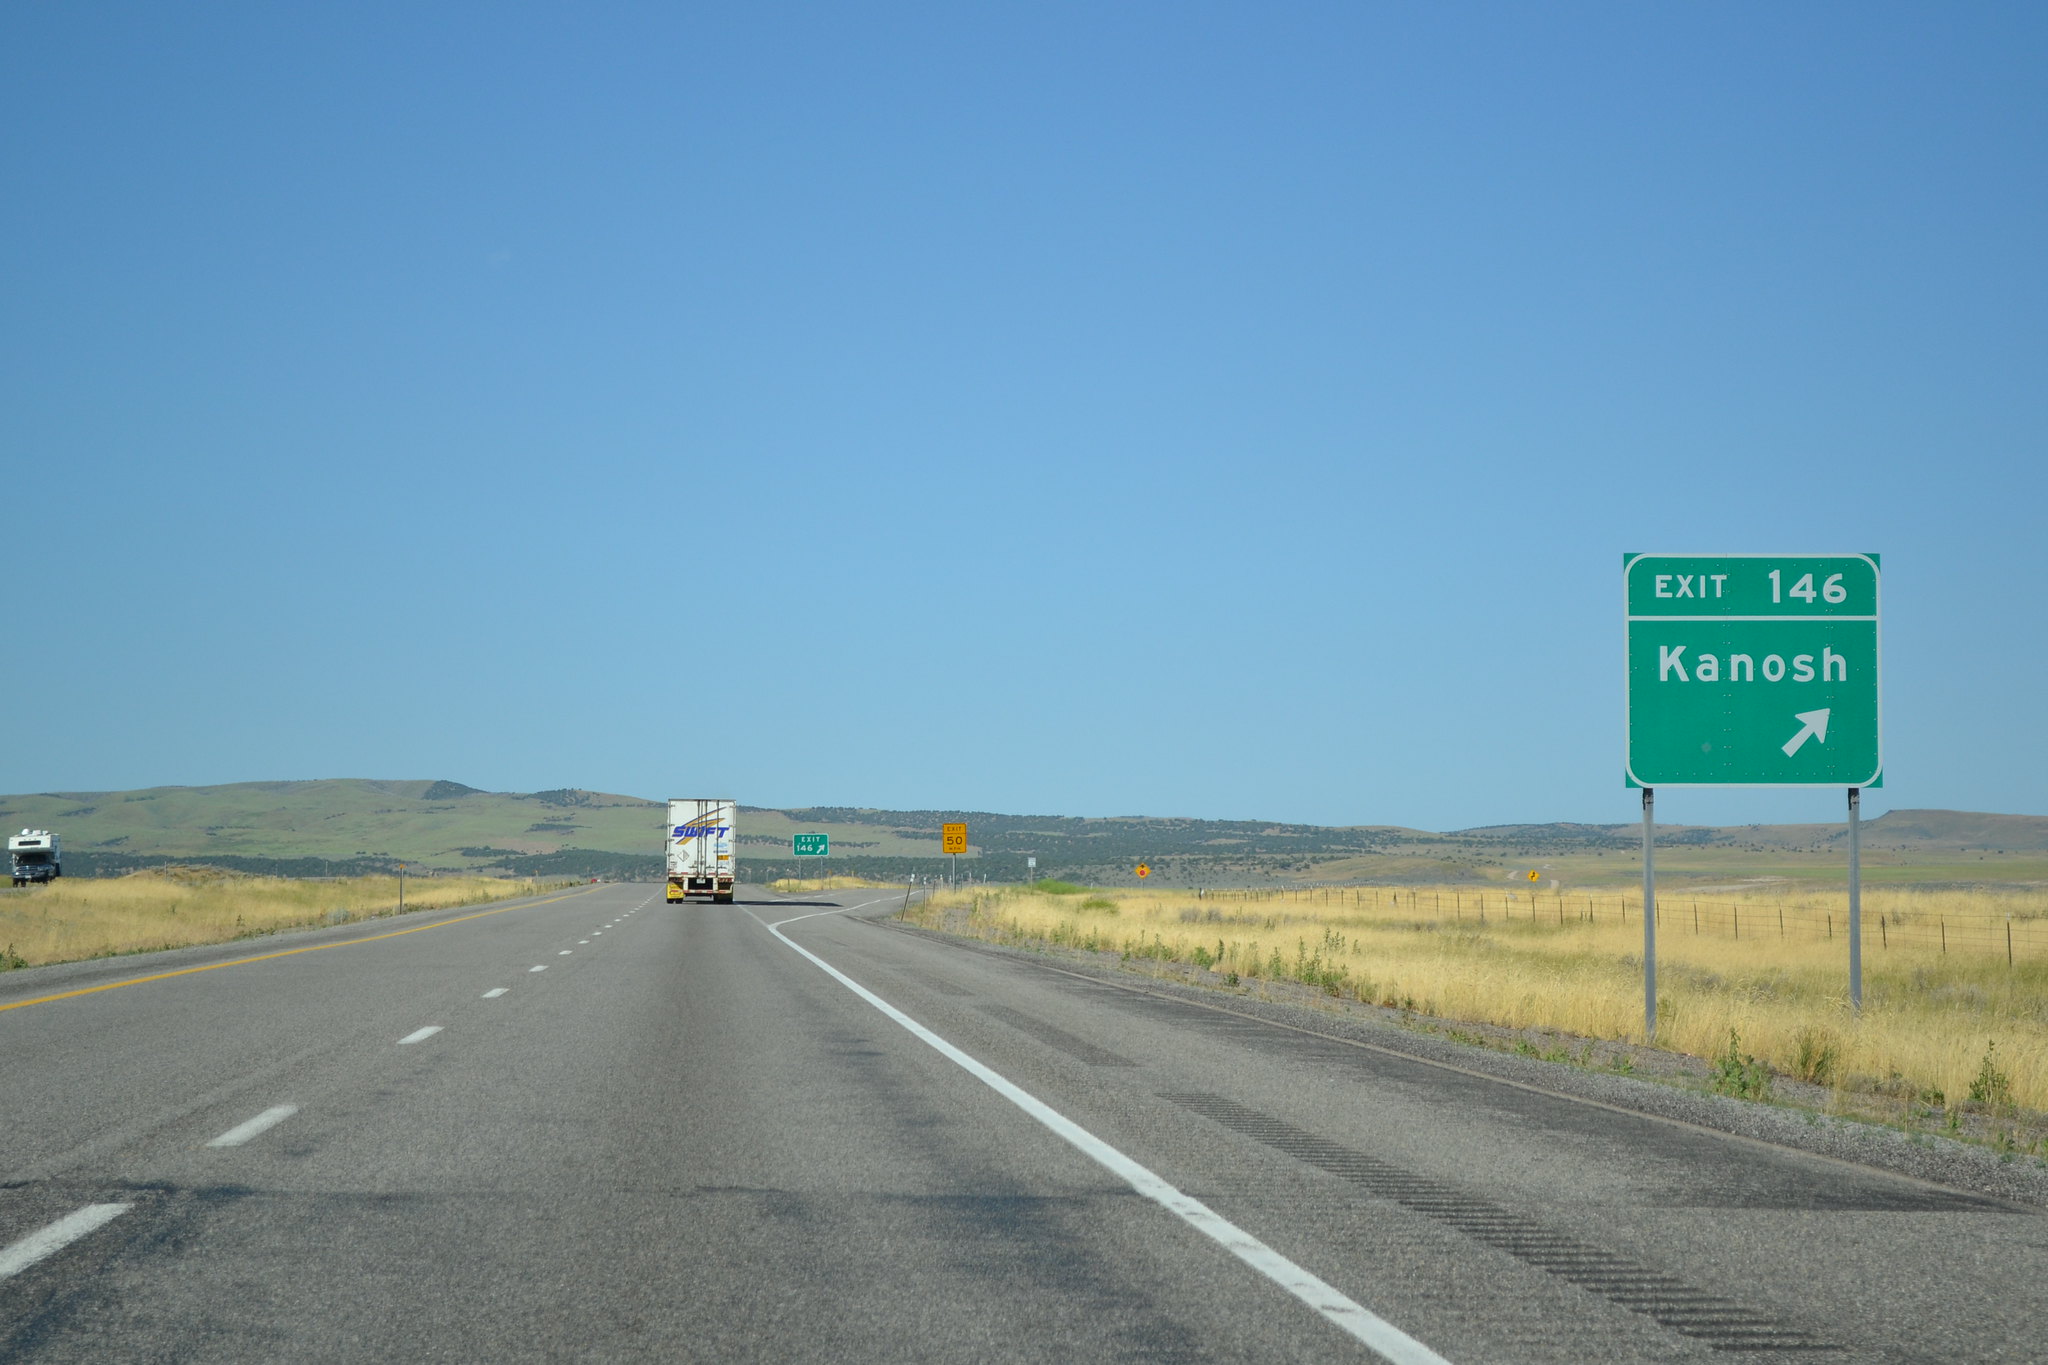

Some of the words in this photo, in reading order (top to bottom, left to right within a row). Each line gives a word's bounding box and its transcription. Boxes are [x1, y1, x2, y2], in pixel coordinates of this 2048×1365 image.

[1655, 575, 1727, 598] EXIT
[1768, 569, 1847, 603] 146
[1659, 645, 1847, 682] Kanosh
[672, 824, 730, 838] SWIFT
[946, 836, 963, 845] 50
[796, 844, 813, 852] 146
